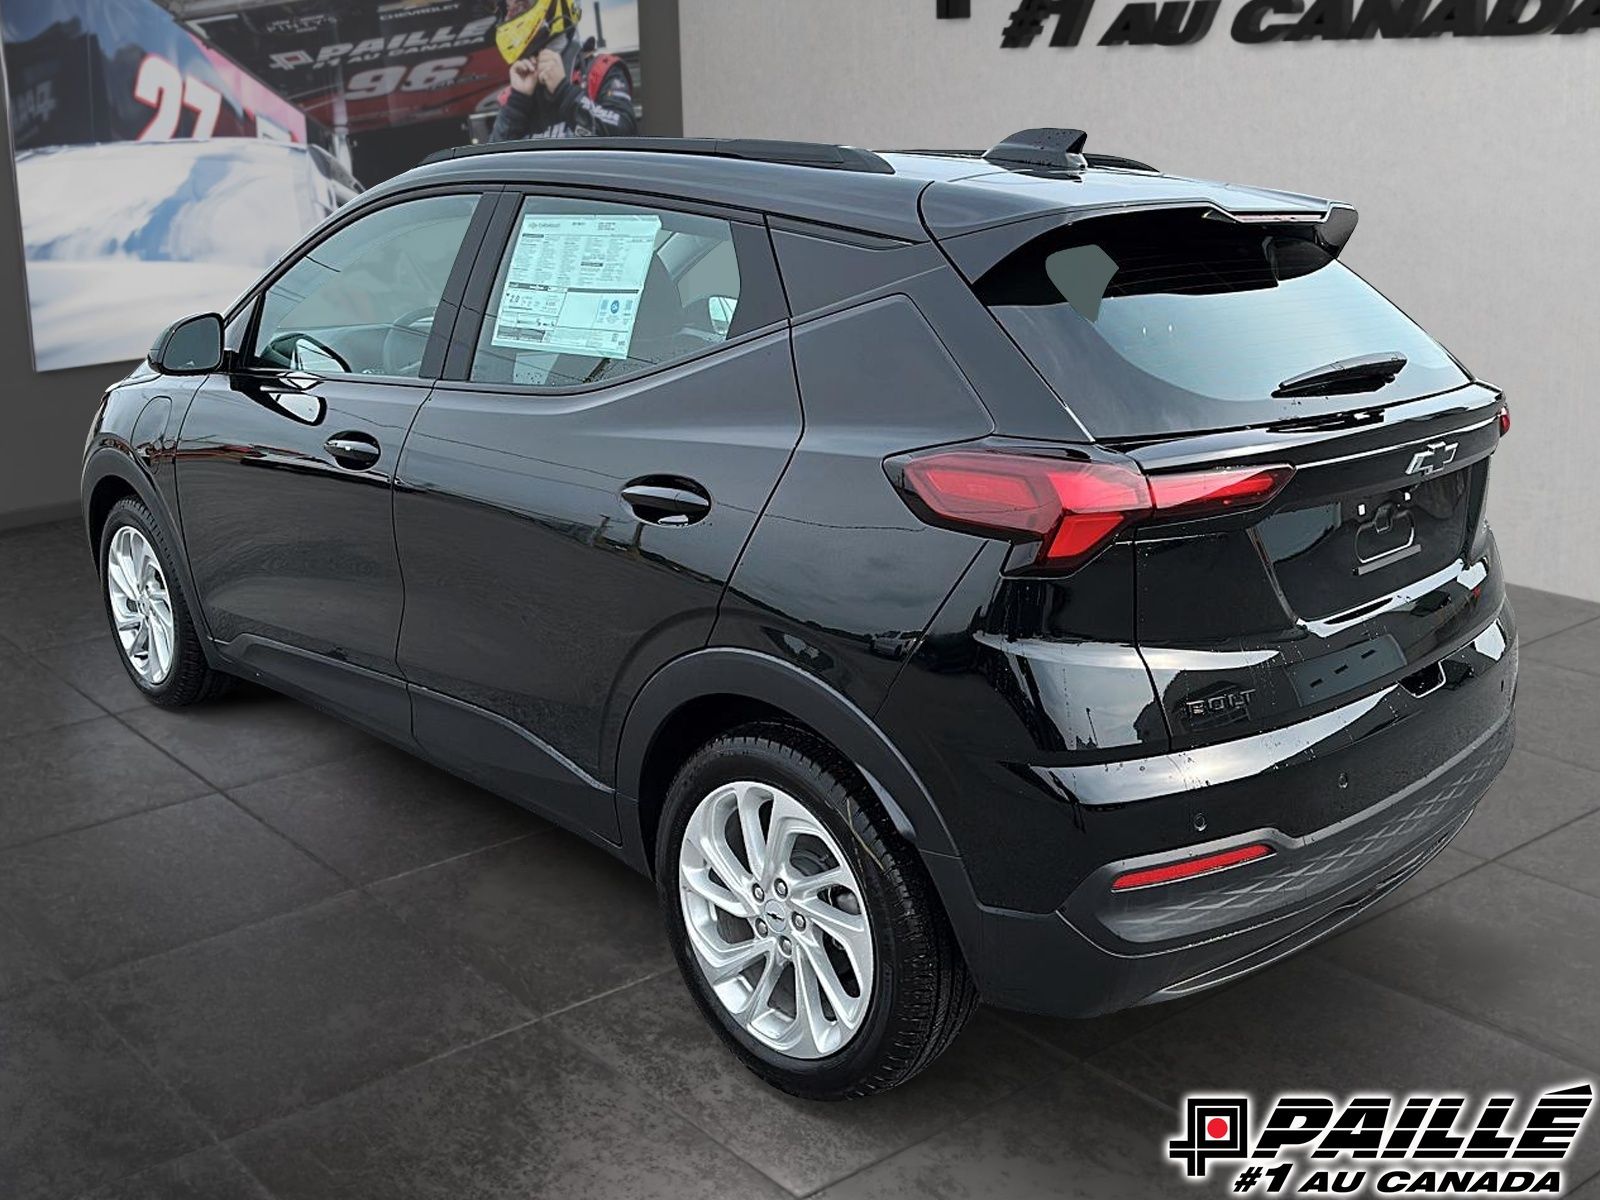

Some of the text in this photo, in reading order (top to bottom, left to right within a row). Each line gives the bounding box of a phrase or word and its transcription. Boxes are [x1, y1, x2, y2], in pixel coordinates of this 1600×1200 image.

[379, 4, 460, 21] CHEVROLET
[1096, 0, 1222, 46] AU
[347, 51, 380, 64] AU
[388, 36, 485, 57] CANADA
[344, 55, 468, 100] 96
[133, 52, 222, 142] 27
[1186, 688, 1256, 715] BOLT
